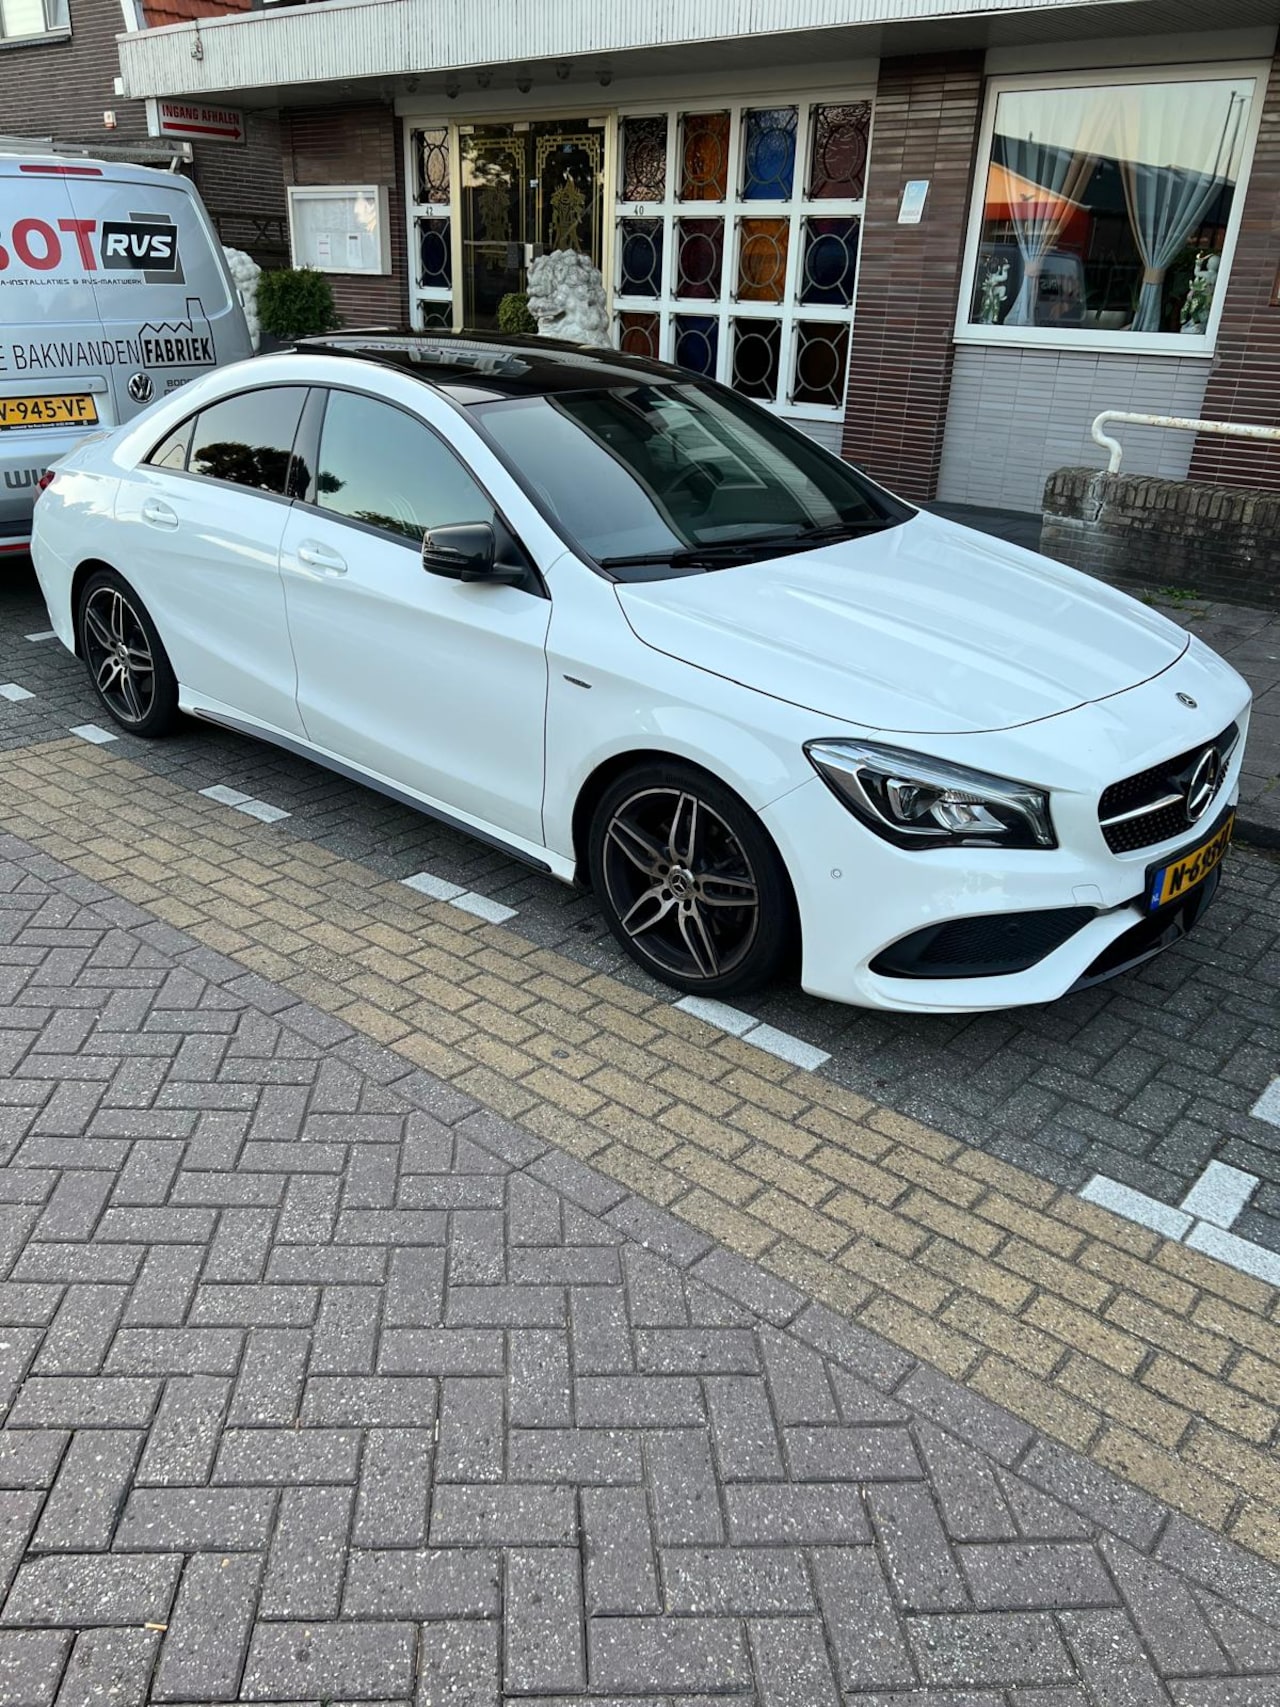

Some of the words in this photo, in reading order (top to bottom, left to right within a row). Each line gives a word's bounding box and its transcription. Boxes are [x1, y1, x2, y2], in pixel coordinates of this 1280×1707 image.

[162, 104, 199, 120] INGANG
[201, 109, 240, 125] AFHALEN
[0, 217, 97, 271] OT
[106, 233, 172, 258] RVS
[12, 339, 141, 370] BAKWANDEN
[143, 337, 213, 363] FABRIEK
